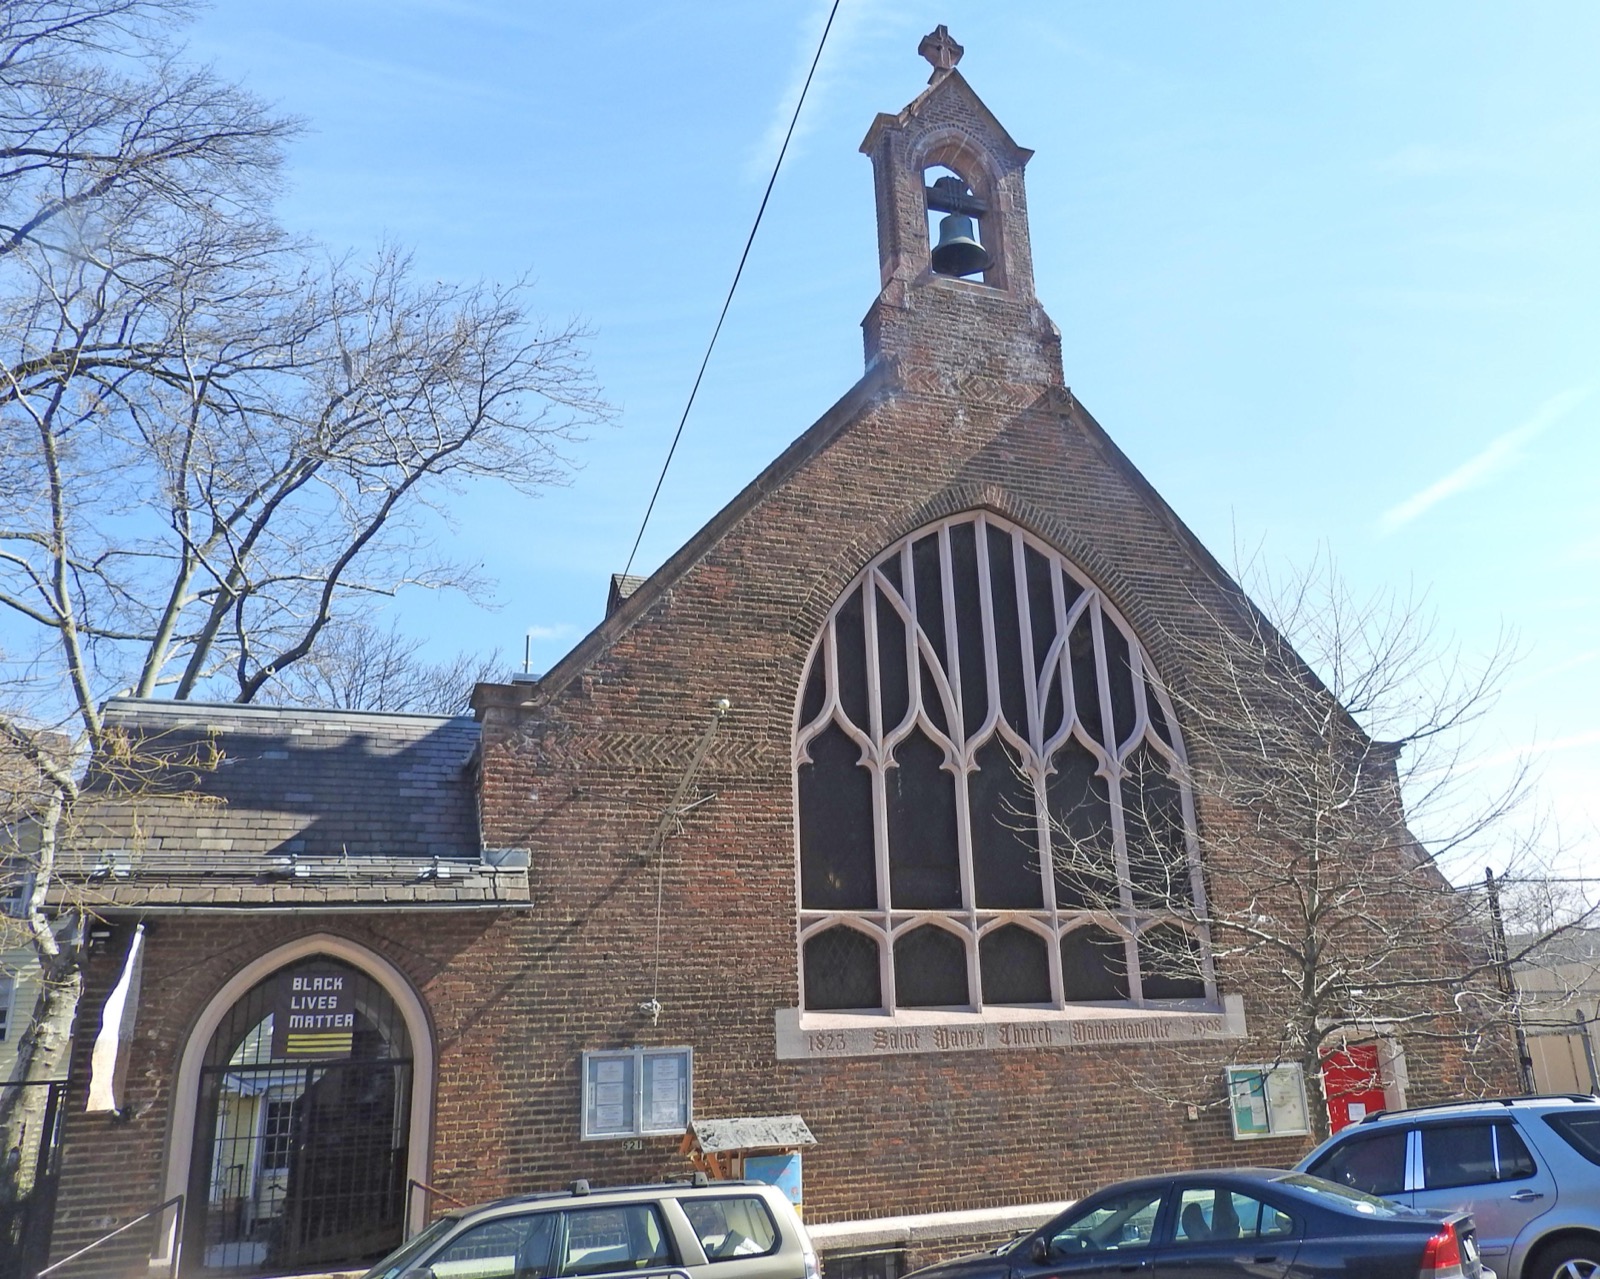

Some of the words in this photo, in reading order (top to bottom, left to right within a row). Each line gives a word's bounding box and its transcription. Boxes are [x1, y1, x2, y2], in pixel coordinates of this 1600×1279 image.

[292, 977, 343, 991] BLACK
[290, 996, 338, 1010] LIVES
[289, 1013, 354, 1028] MATTER
[808, 1029, 846, 1051] 1823
[873, 1028, 920, 1051] Saint
[999, 1021, 1052, 1045] Church
[1192, 1018, 1222, 1036] 1908
